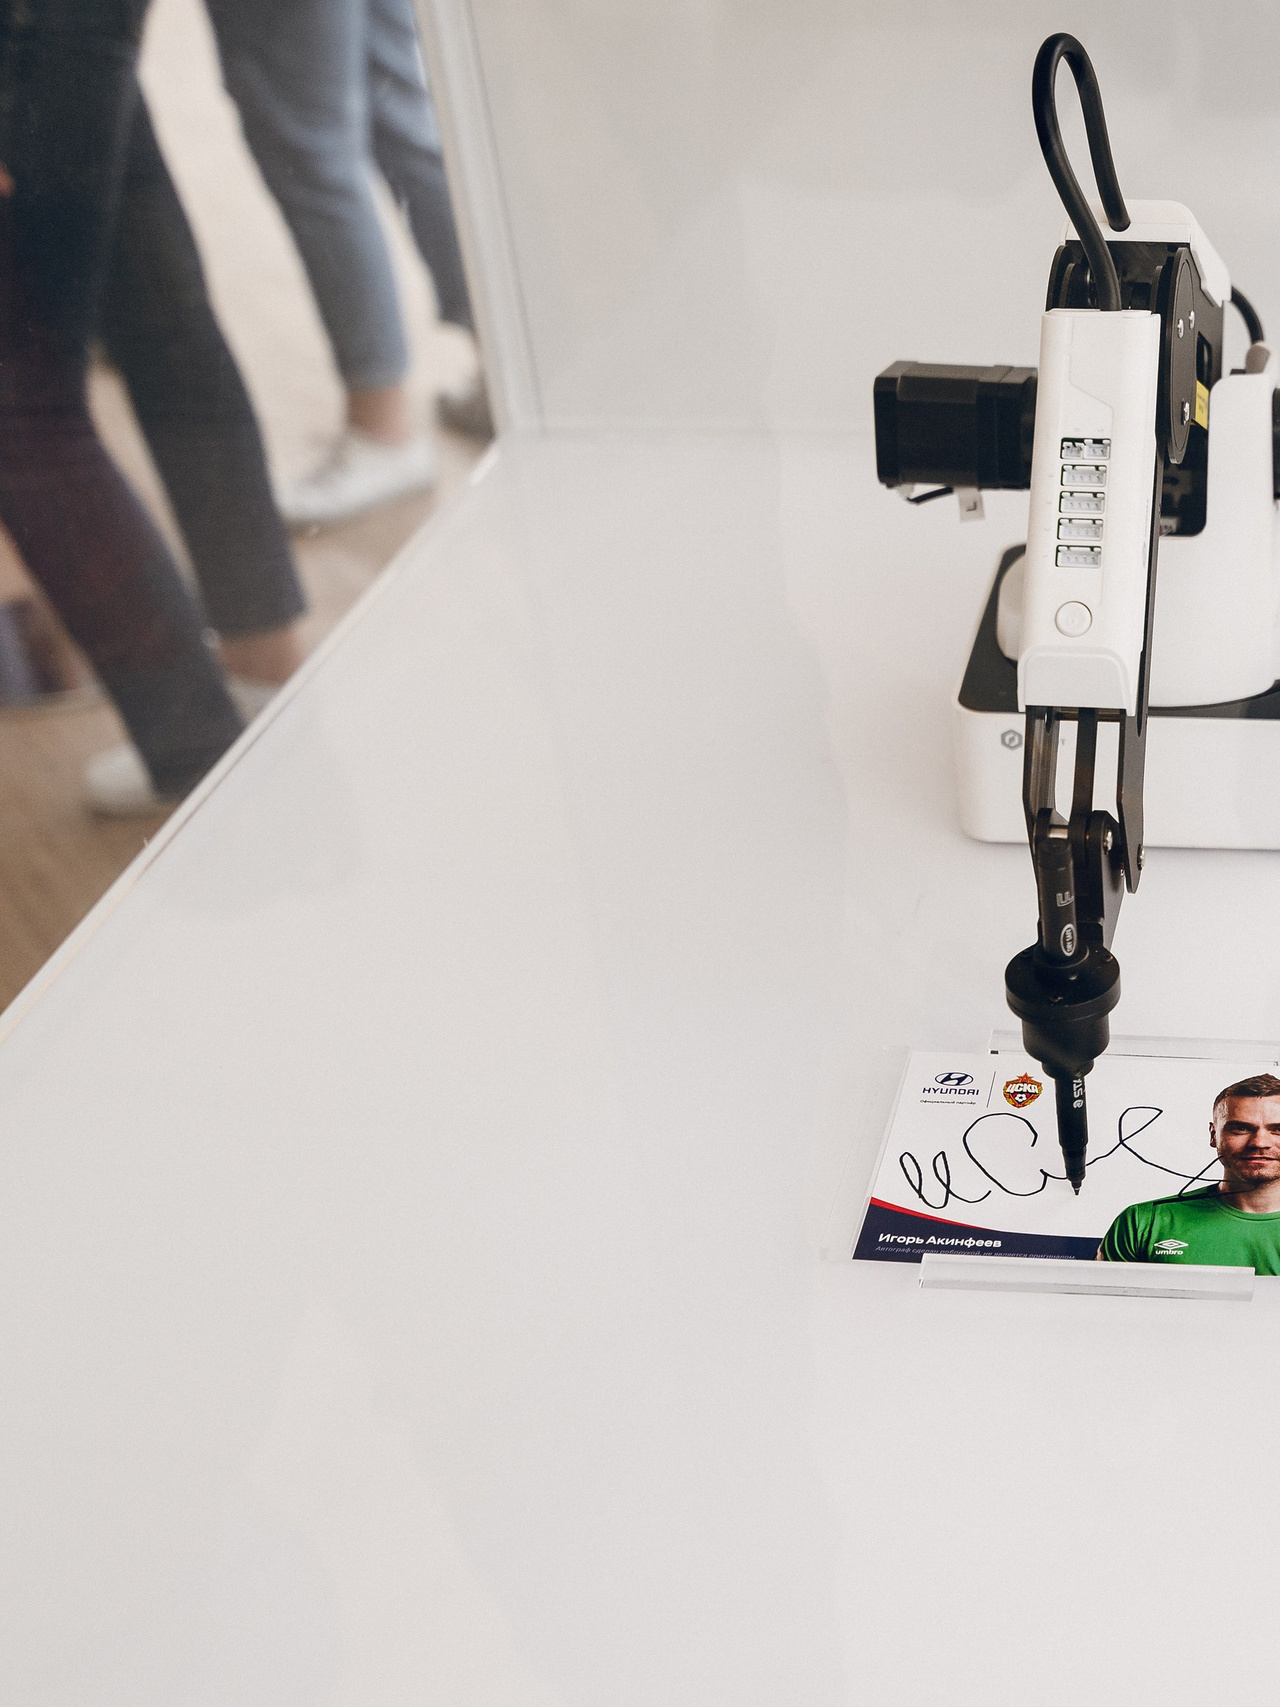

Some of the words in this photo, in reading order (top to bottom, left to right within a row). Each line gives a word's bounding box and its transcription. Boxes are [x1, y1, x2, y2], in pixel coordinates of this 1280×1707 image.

[922, 1087, 980, 1096] HYUNDAI
[1005, 1083, 1039, 1094] ЦСКА
[878, 1233, 924, 1245] Игорь
[925, 1234, 1002, 1248] Акинфеев
